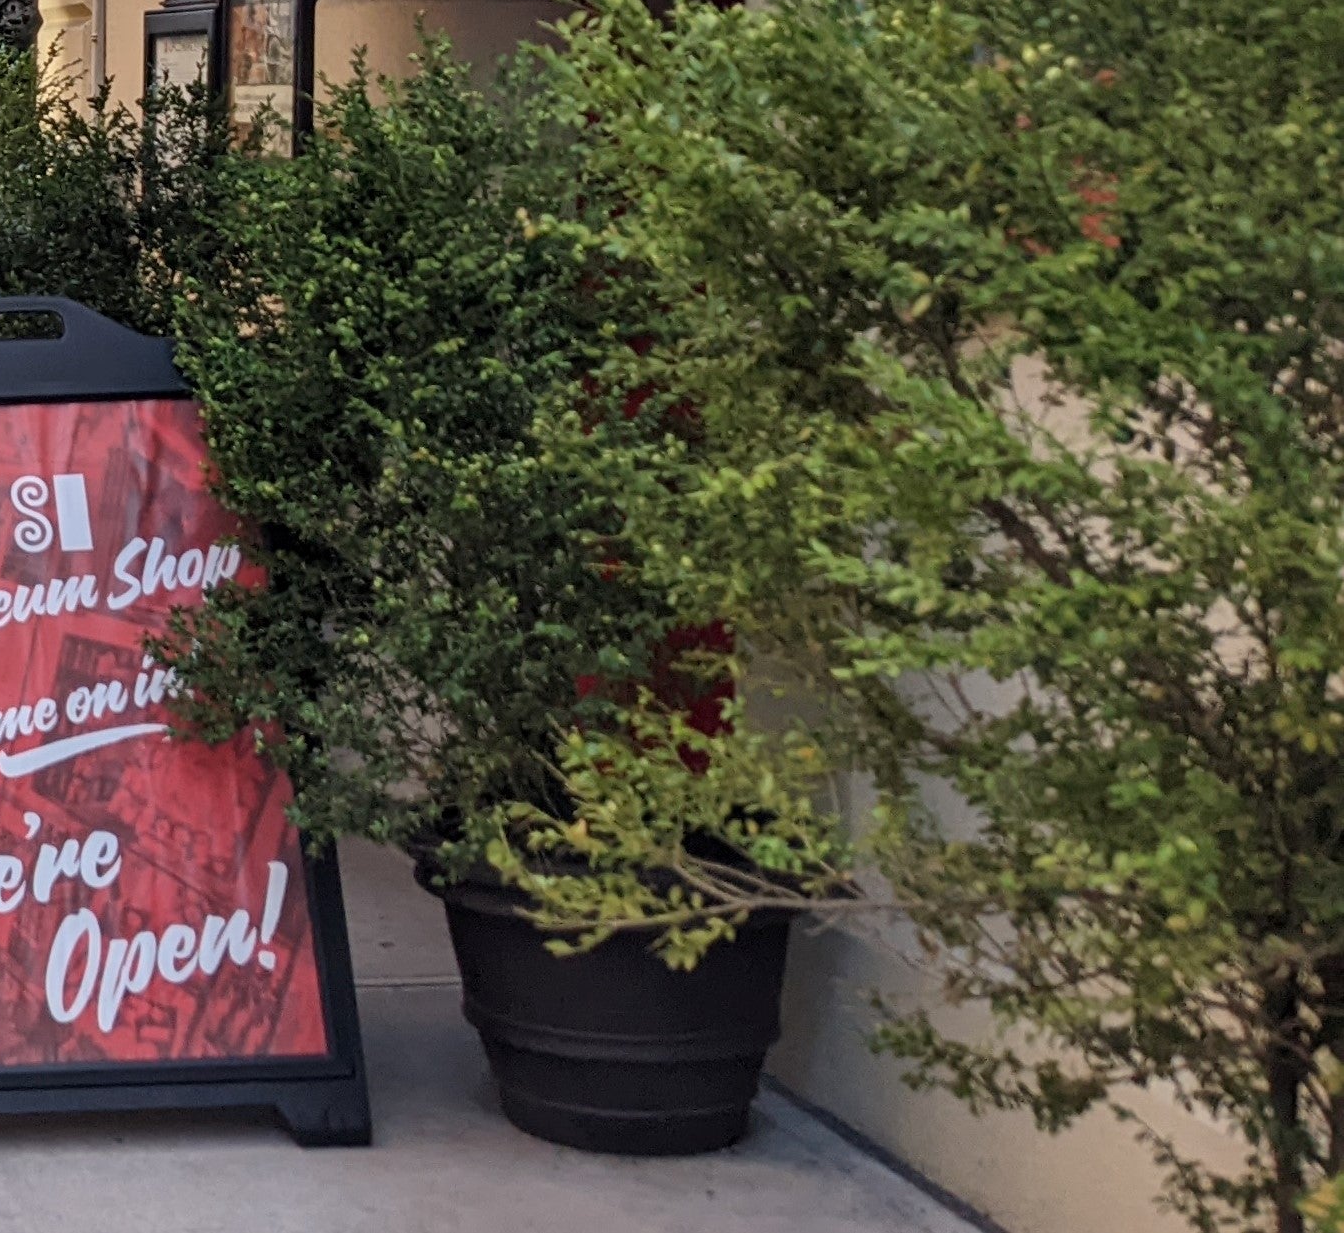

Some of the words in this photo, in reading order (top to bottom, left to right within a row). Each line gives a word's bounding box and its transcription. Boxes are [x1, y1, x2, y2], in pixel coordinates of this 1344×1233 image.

[106, 536, 242, 603] Shop
[65, 679, 129, 720] on
[134, 644, 195, 709] in
[45, 861, 288, 1033] Open!
